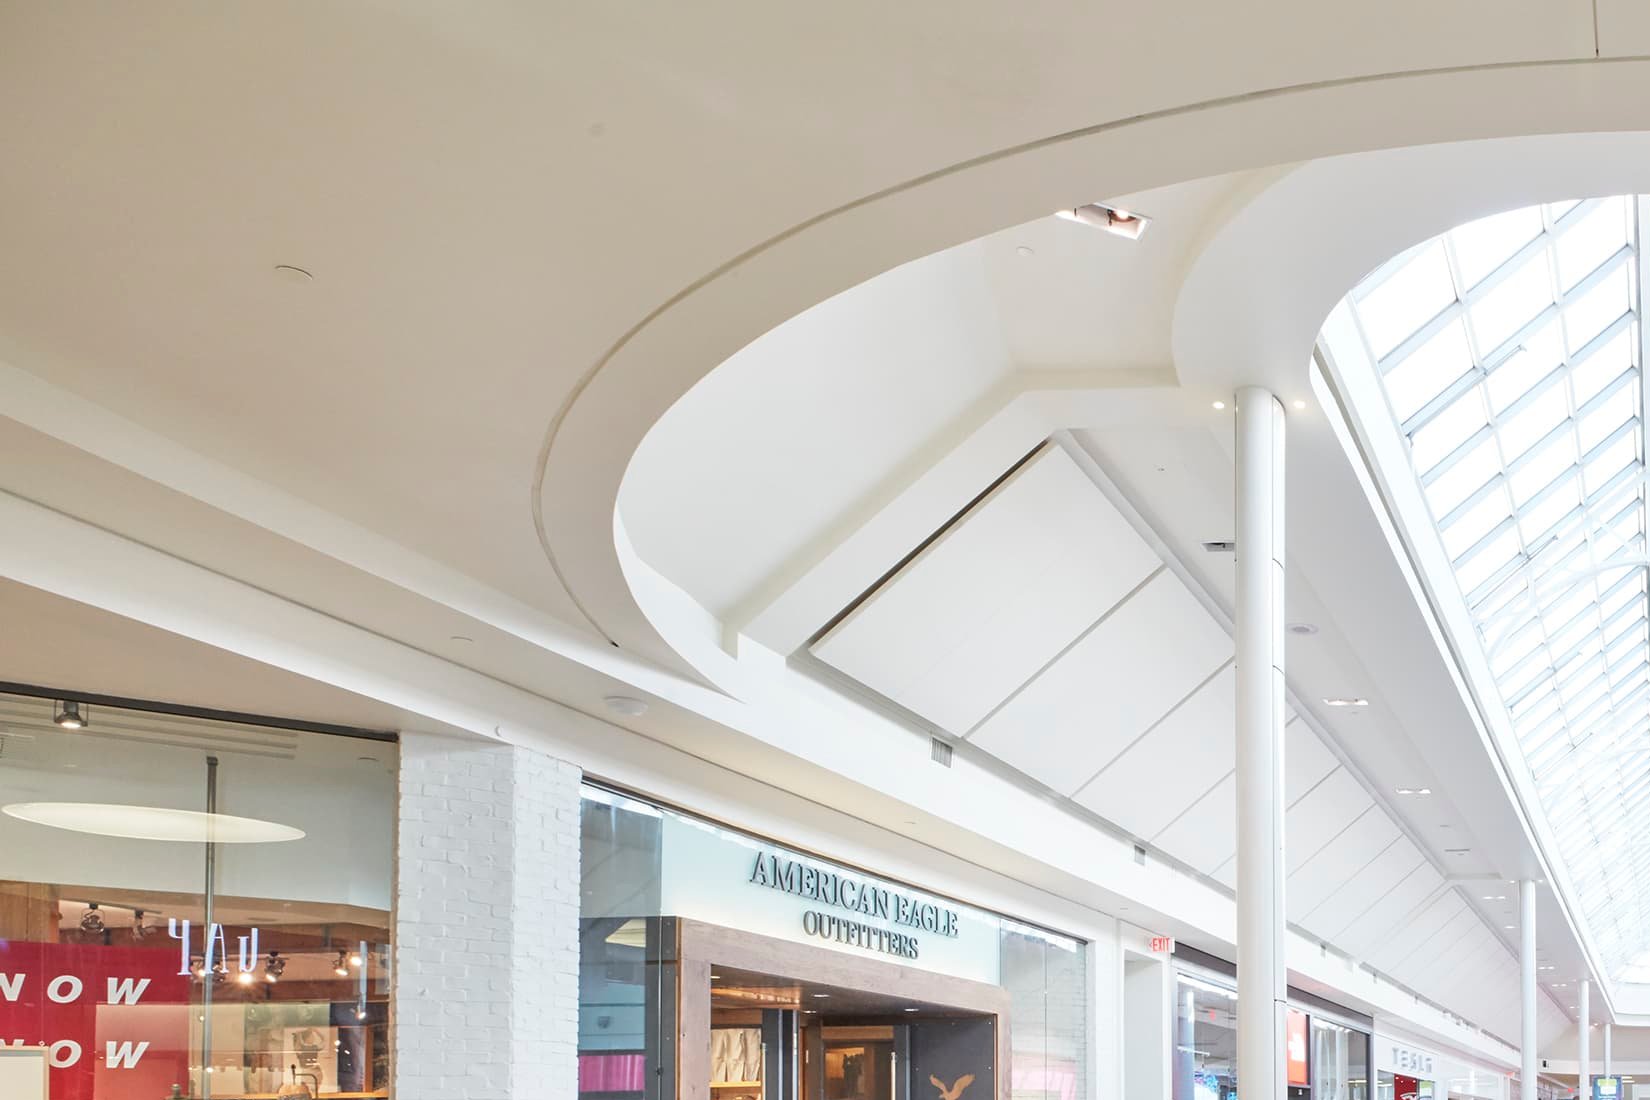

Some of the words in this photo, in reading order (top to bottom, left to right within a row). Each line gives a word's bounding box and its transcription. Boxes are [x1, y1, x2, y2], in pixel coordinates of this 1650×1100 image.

[750, 851, 889, 920] AMERICAN
[895, 893, 959, 938] EAGLE
[803, 910, 918, 959] OUTFITTERS
[1152, 937, 1169, 952] EXIT
[0, 1039, 149, 1069] OW
[1392, 1047, 1432, 1073] TESLA
